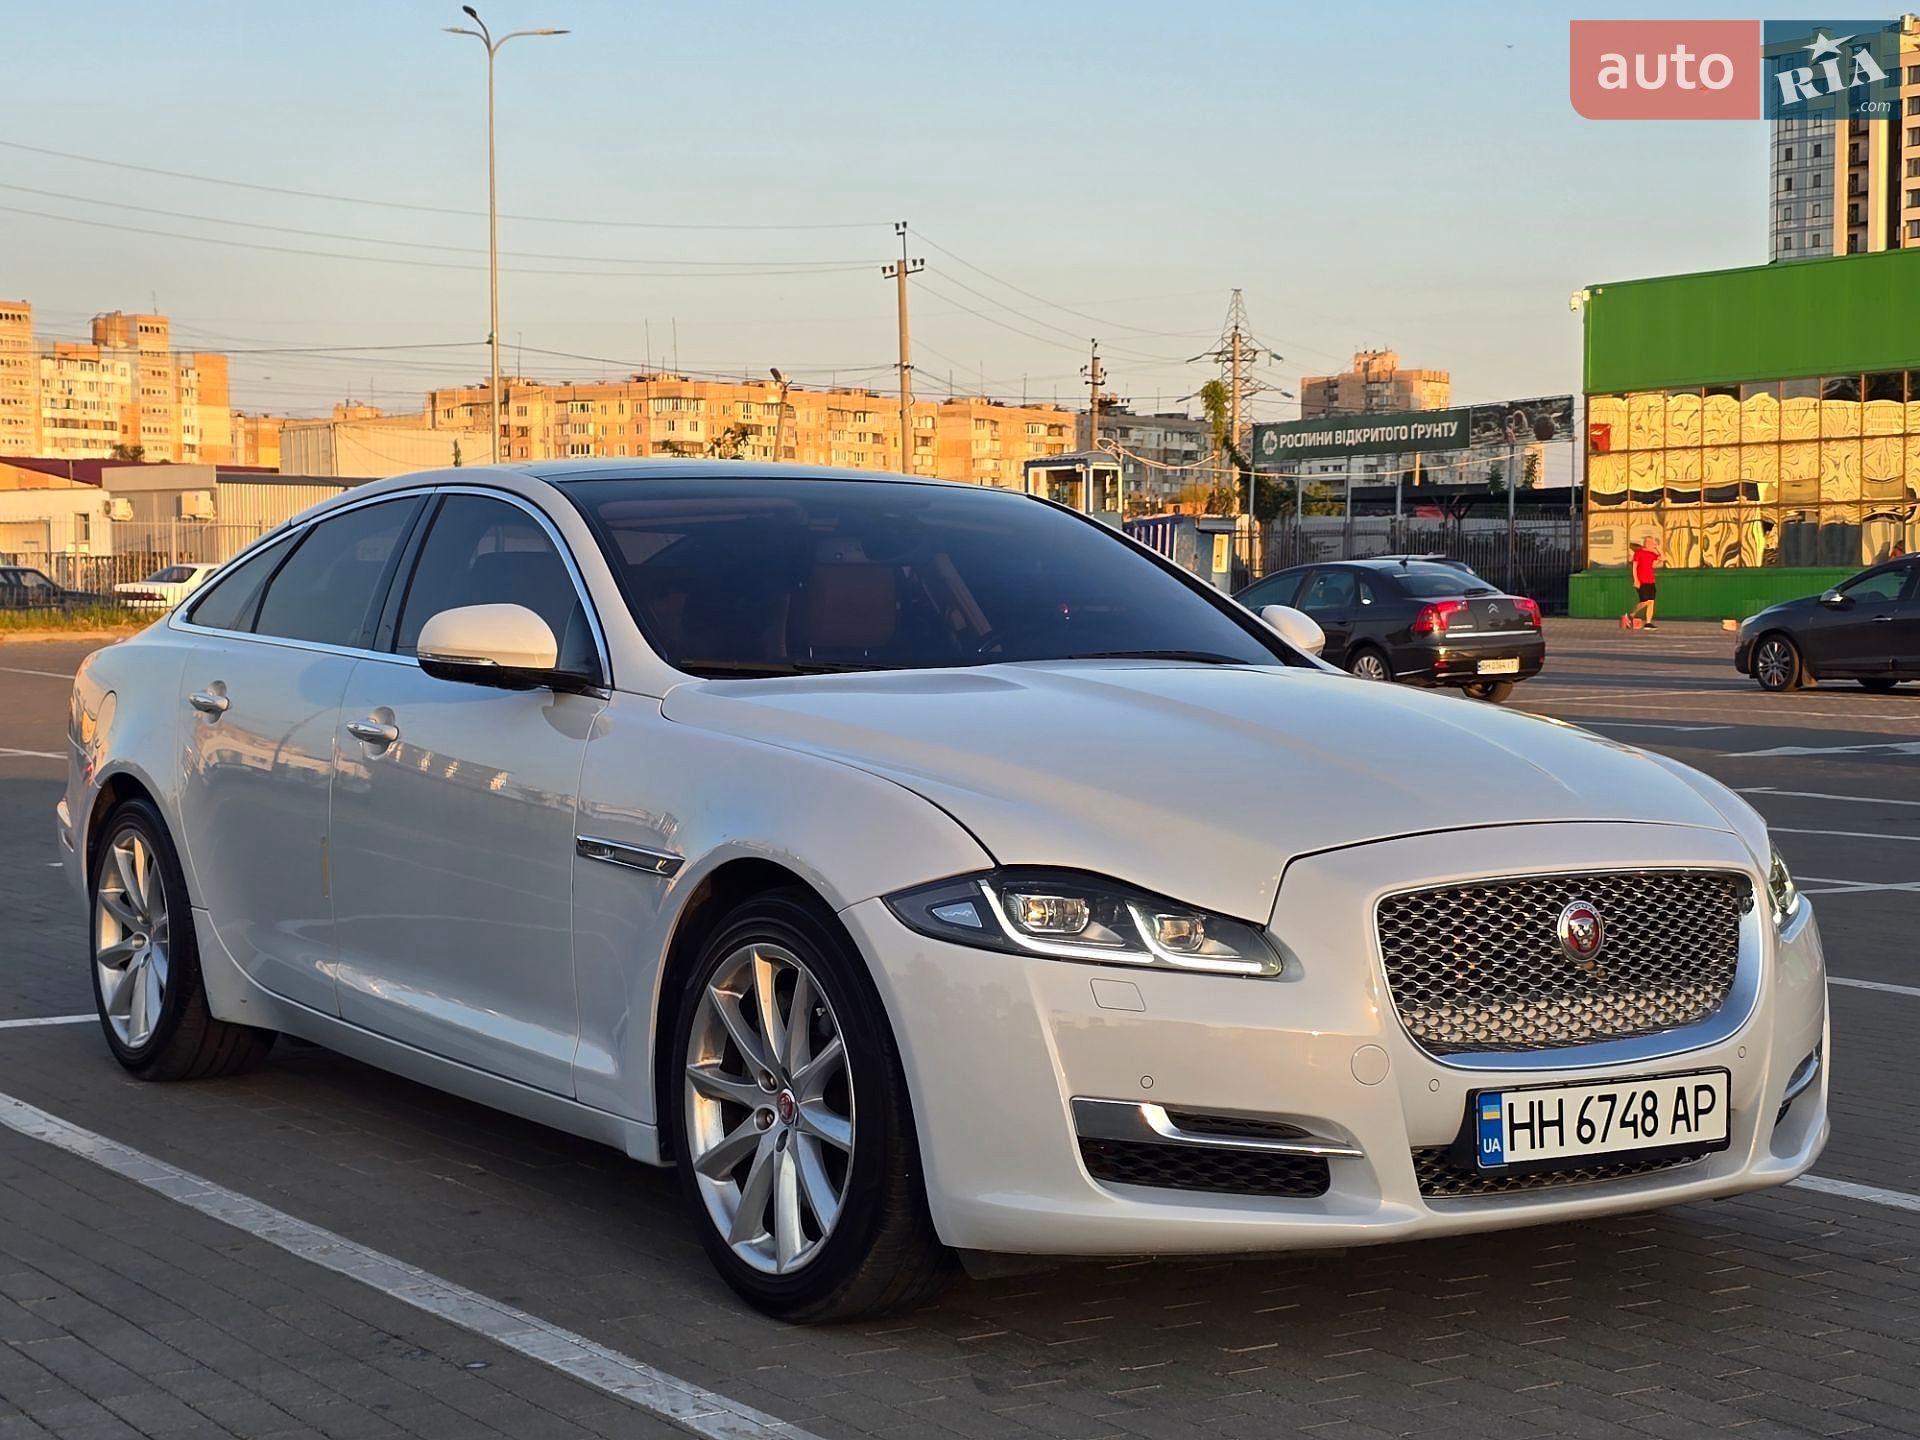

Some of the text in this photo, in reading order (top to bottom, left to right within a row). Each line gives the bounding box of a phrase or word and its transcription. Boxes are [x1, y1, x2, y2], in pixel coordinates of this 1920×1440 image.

[1279, 420, 1459, 449] РОСЛИНИ ВІДКРИТОГО ҐРУНТУ
[1508, 1084, 1716, 1151] HH 6748 AP
[1483, 1138, 1501, 1154] UA
